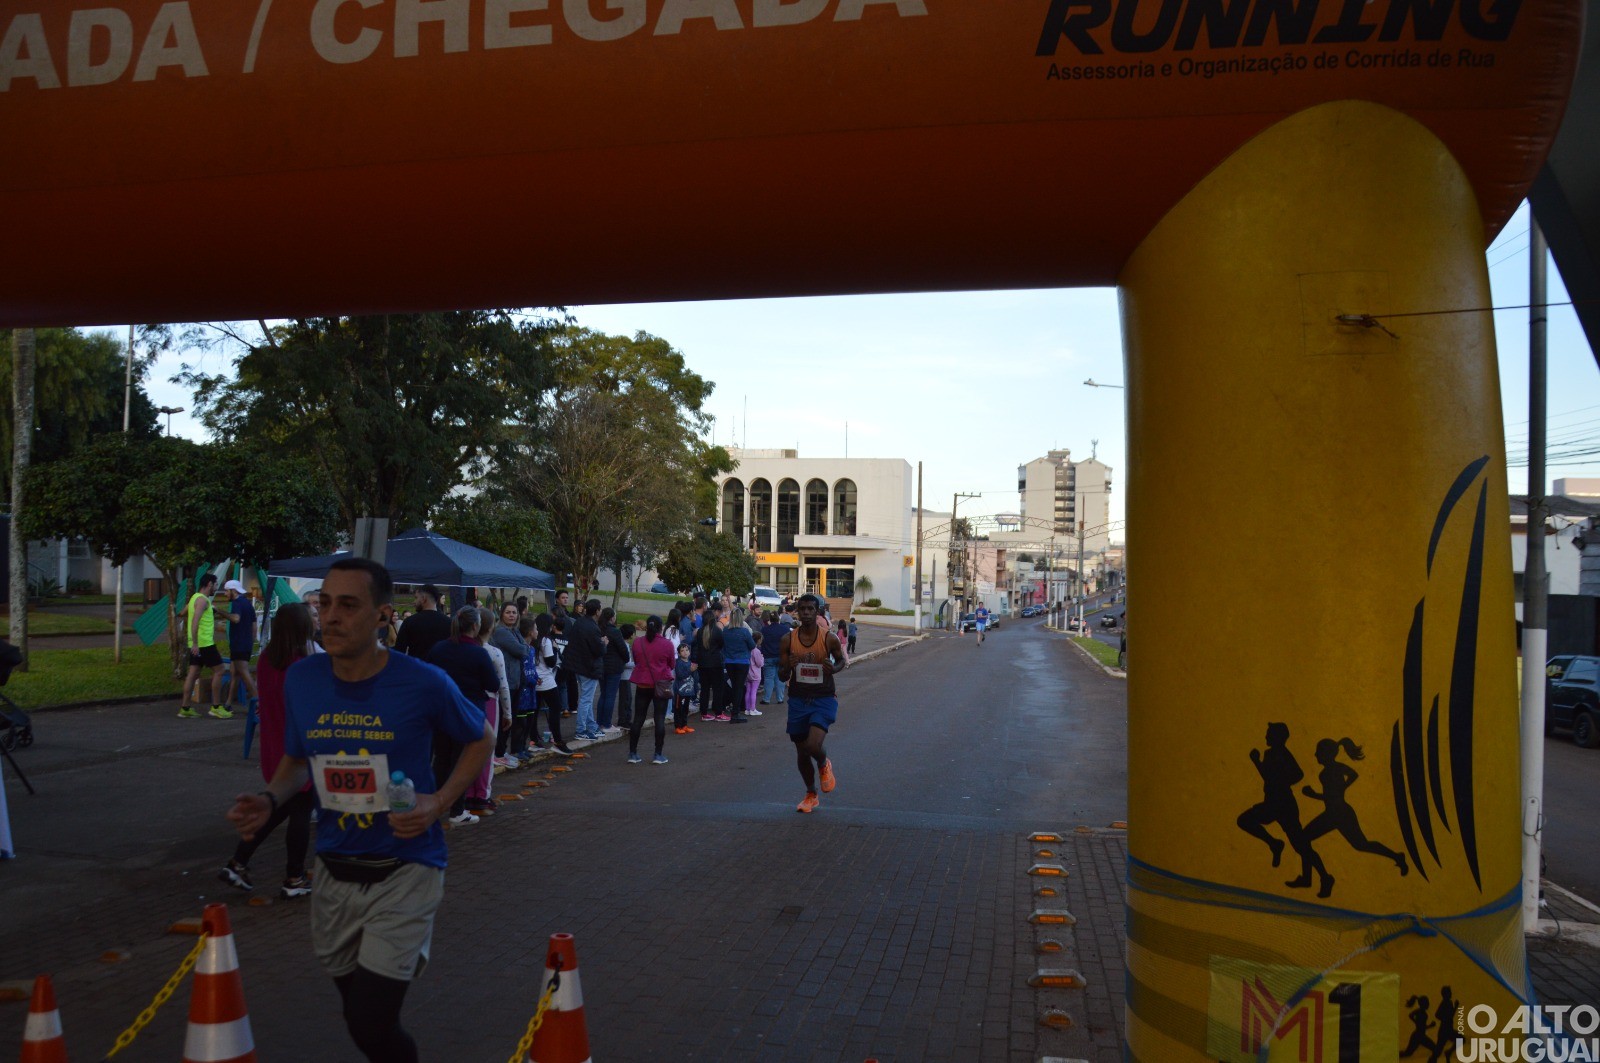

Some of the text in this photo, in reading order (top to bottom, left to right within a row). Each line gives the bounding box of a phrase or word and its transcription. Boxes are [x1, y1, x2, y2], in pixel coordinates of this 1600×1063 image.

[310, 0, 928, 64] CHEG
[1035, 0, 1520, 56] RUNNING
[1046, 48, 1496, 81] Assessoria e Organização de Corrida de Rua
[332, 710, 382, 727] RÚSTICA
[306, 728, 395, 741] LIONS CLUBE SEBERI
[331, 772, 370, 790] 087
